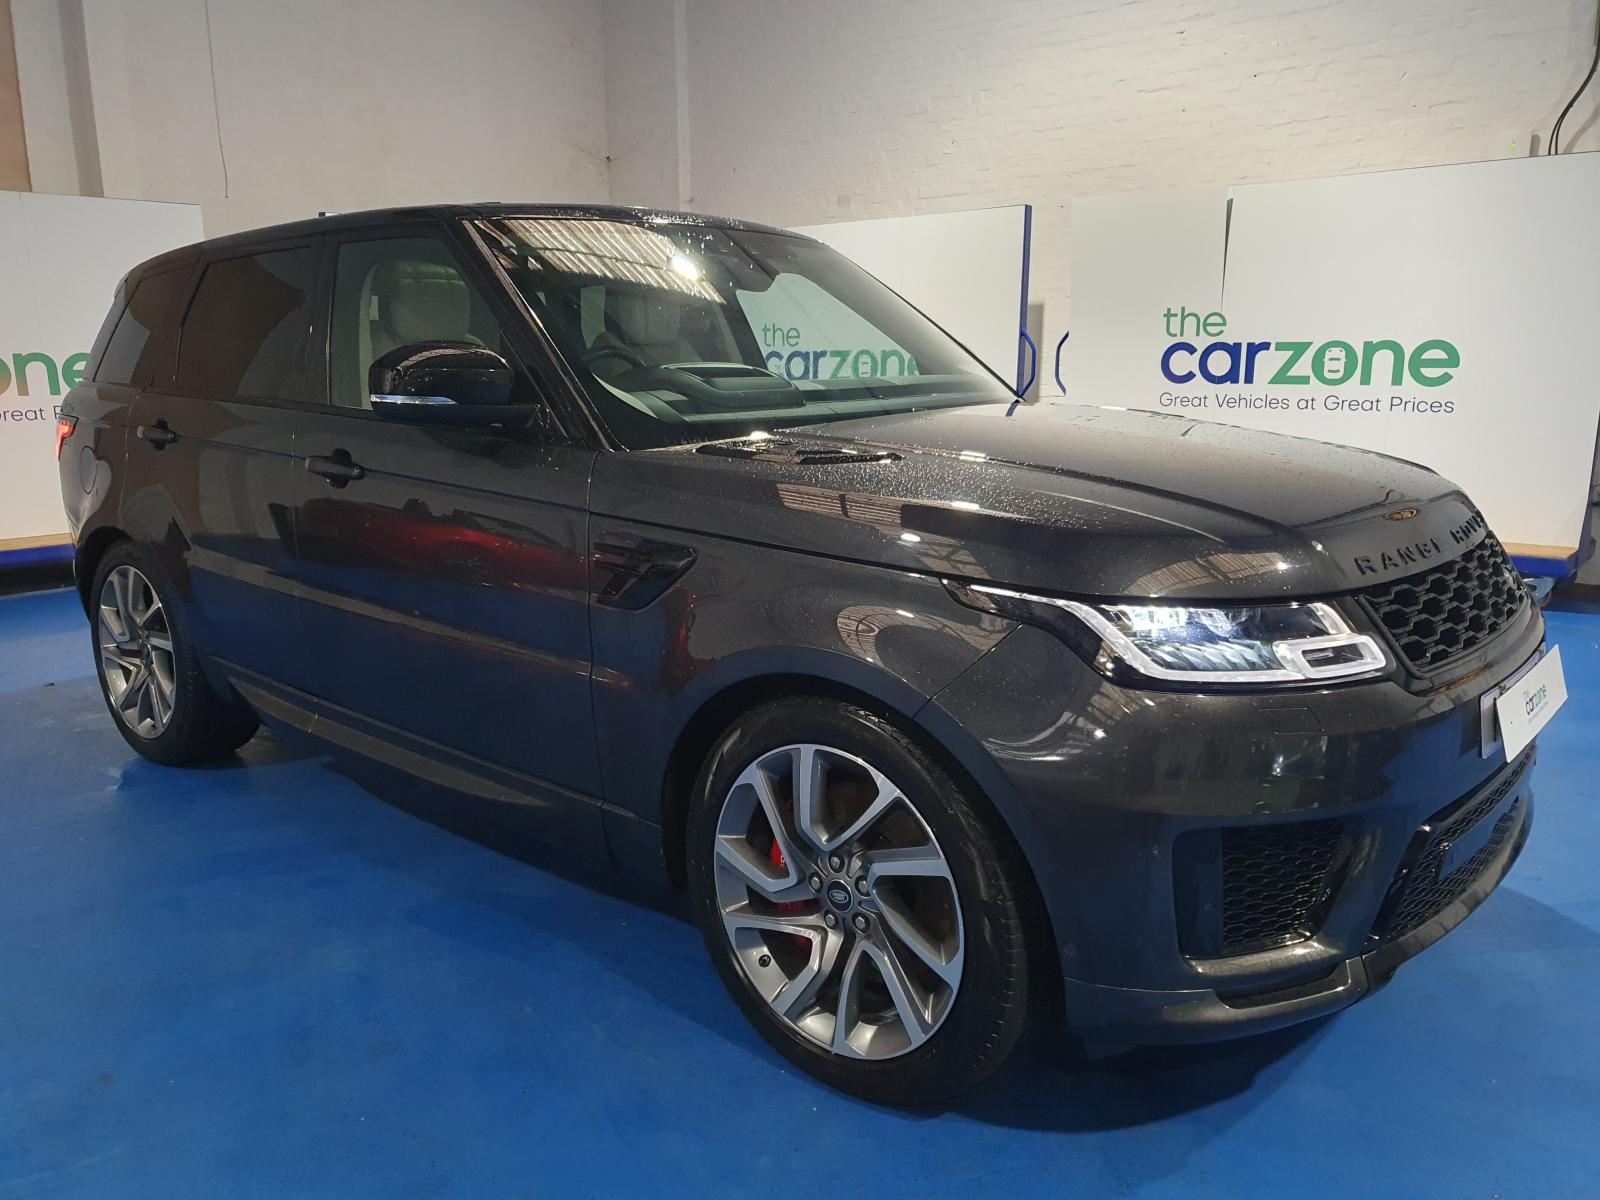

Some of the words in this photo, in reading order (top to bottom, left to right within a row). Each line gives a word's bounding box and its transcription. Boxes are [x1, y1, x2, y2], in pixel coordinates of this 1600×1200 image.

[762, 323, 800, 347] the
[1163, 306, 1228, 338] the
[0, 352, 92, 396] ne
[1160, 339, 1461, 387] carzone
[0, 408, 46, 422] reat
[1159, 391, 1209, 408] Great
[1215, 393, 1290, 411] Vehicles
[1296, 394, 1317, 411] at
[1323, 395, 1382, 413] Great
[1389, 396, 1456, 414] Prices
